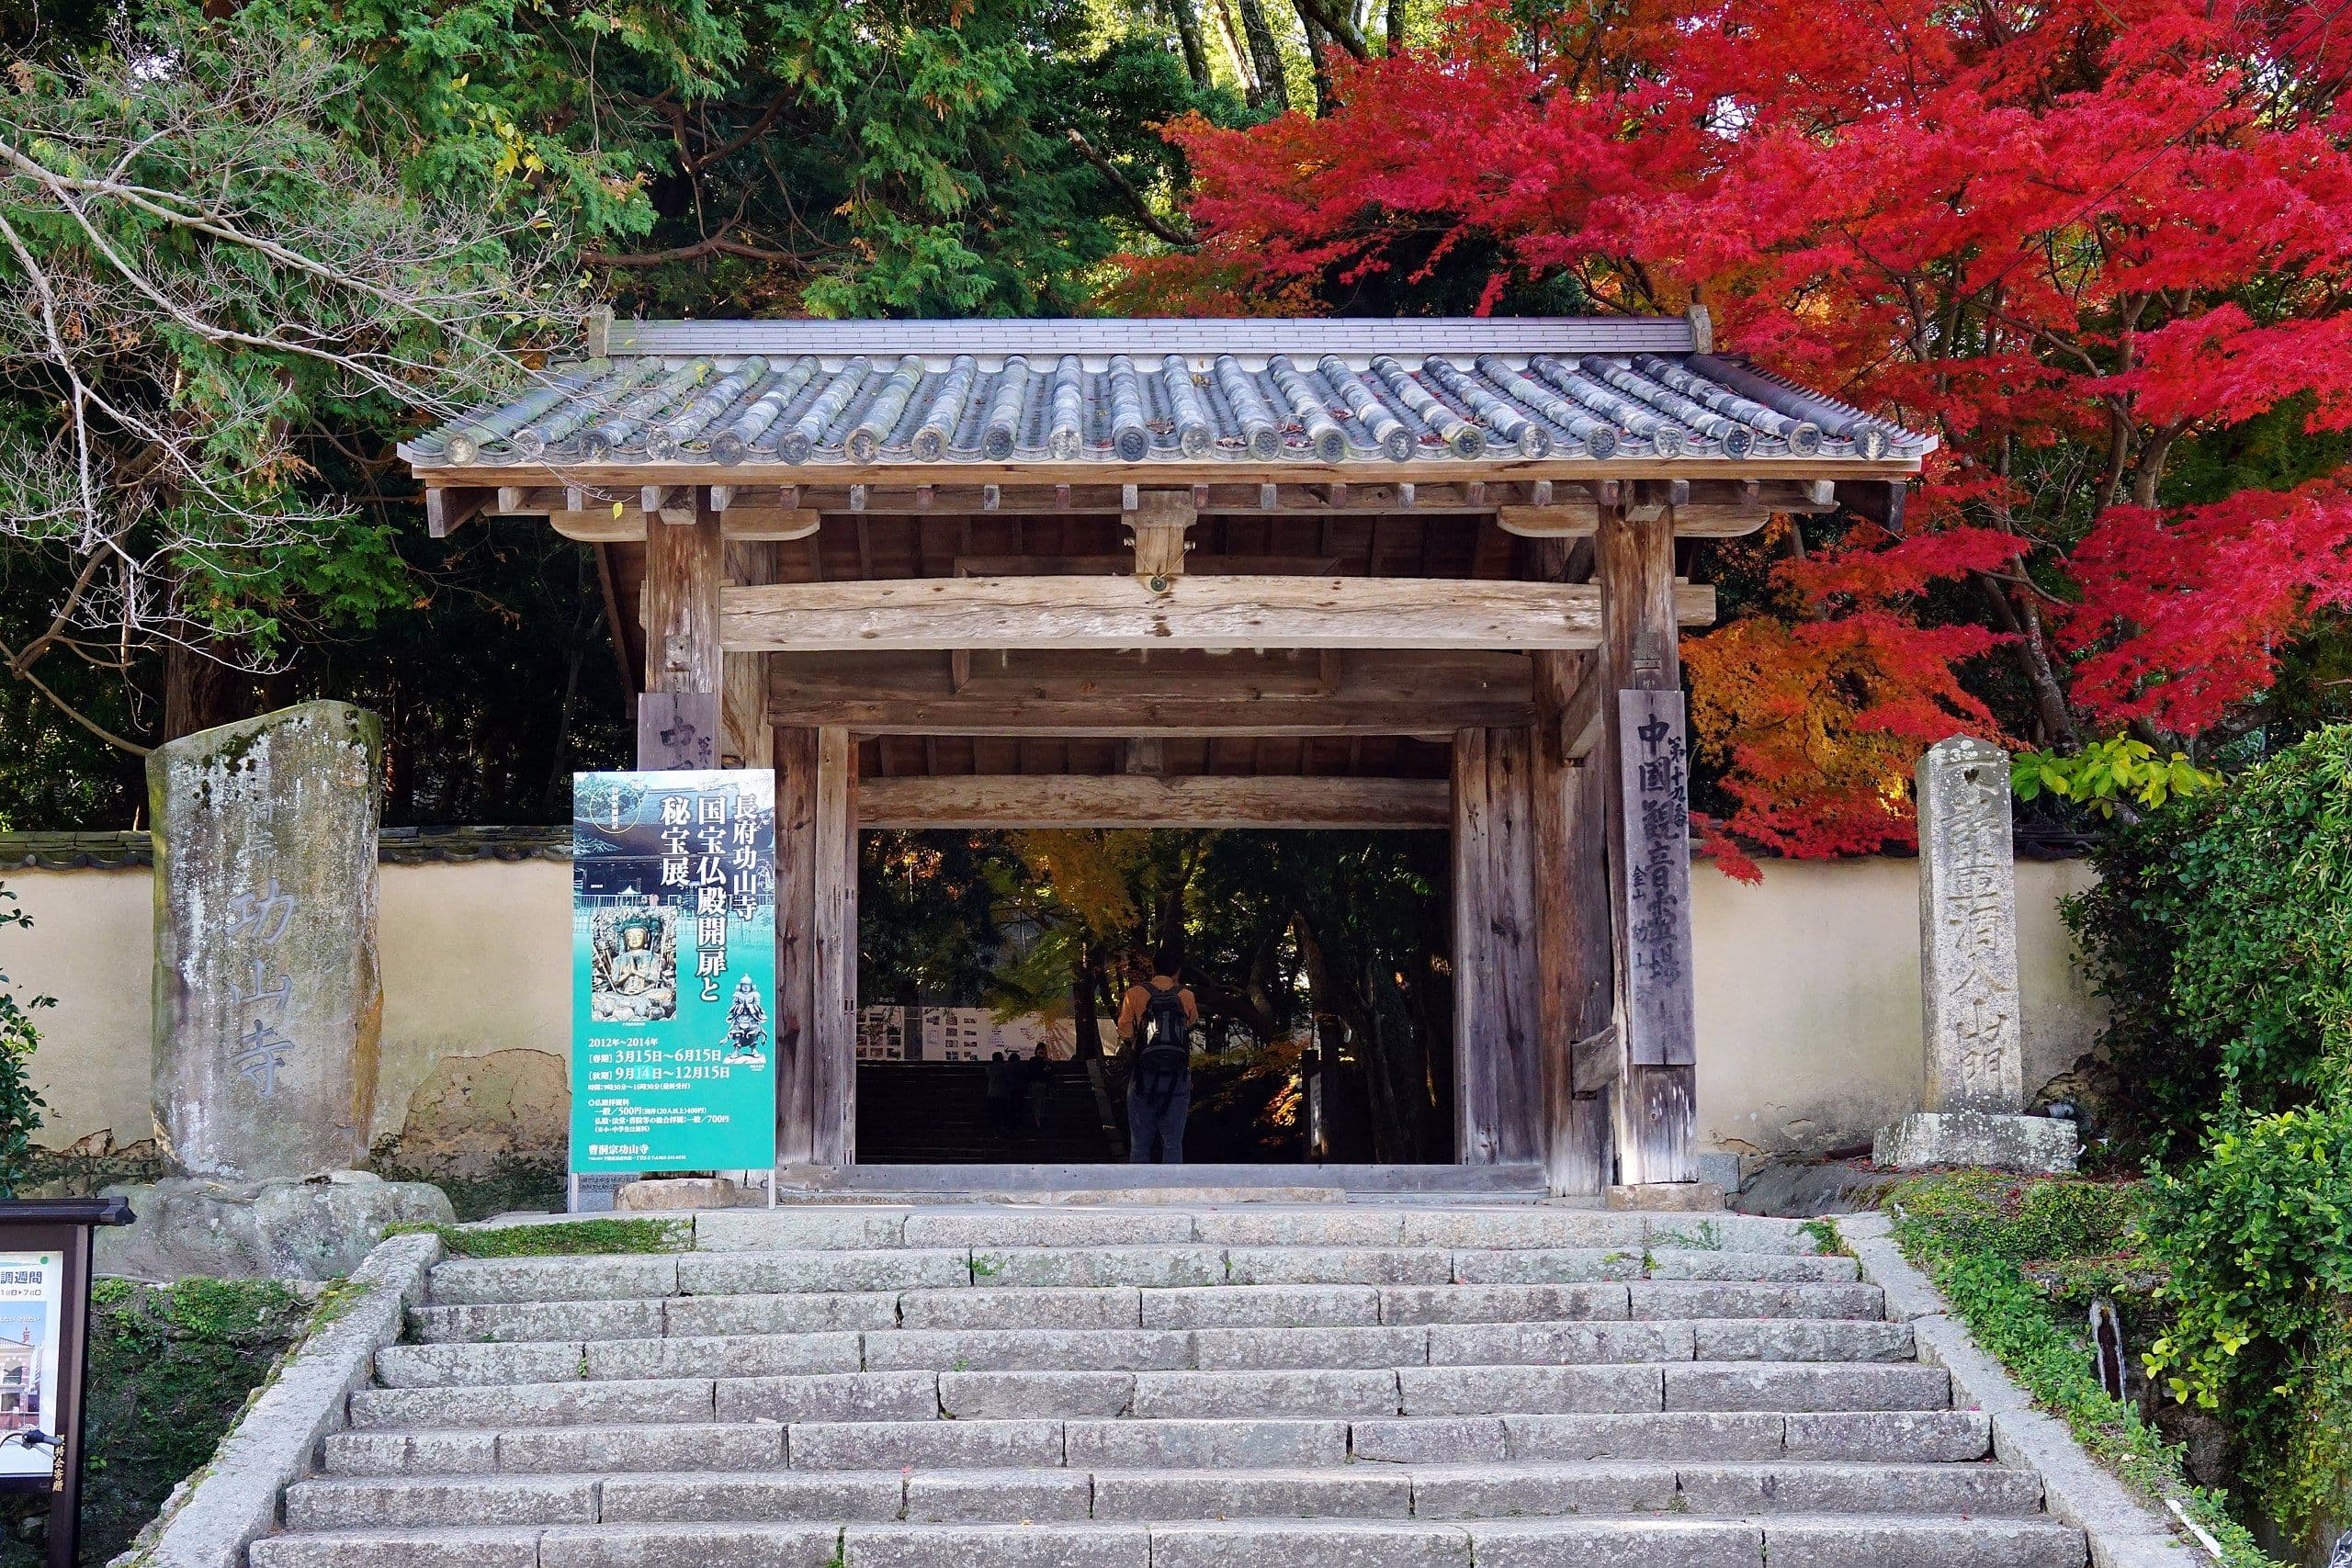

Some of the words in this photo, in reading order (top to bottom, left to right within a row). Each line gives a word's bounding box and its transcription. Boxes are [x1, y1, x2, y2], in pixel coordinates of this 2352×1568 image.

[660, 795, 692, 887] 秘宝展
[695, 795, 728, 1003] 国宝仏殿開扉と
[732, 794, 758, 920] 長府功山寺
[226, 876, 297, 1099] 功山寺
[588, 1144, 650, 1155] 曹洞宗功山寺
